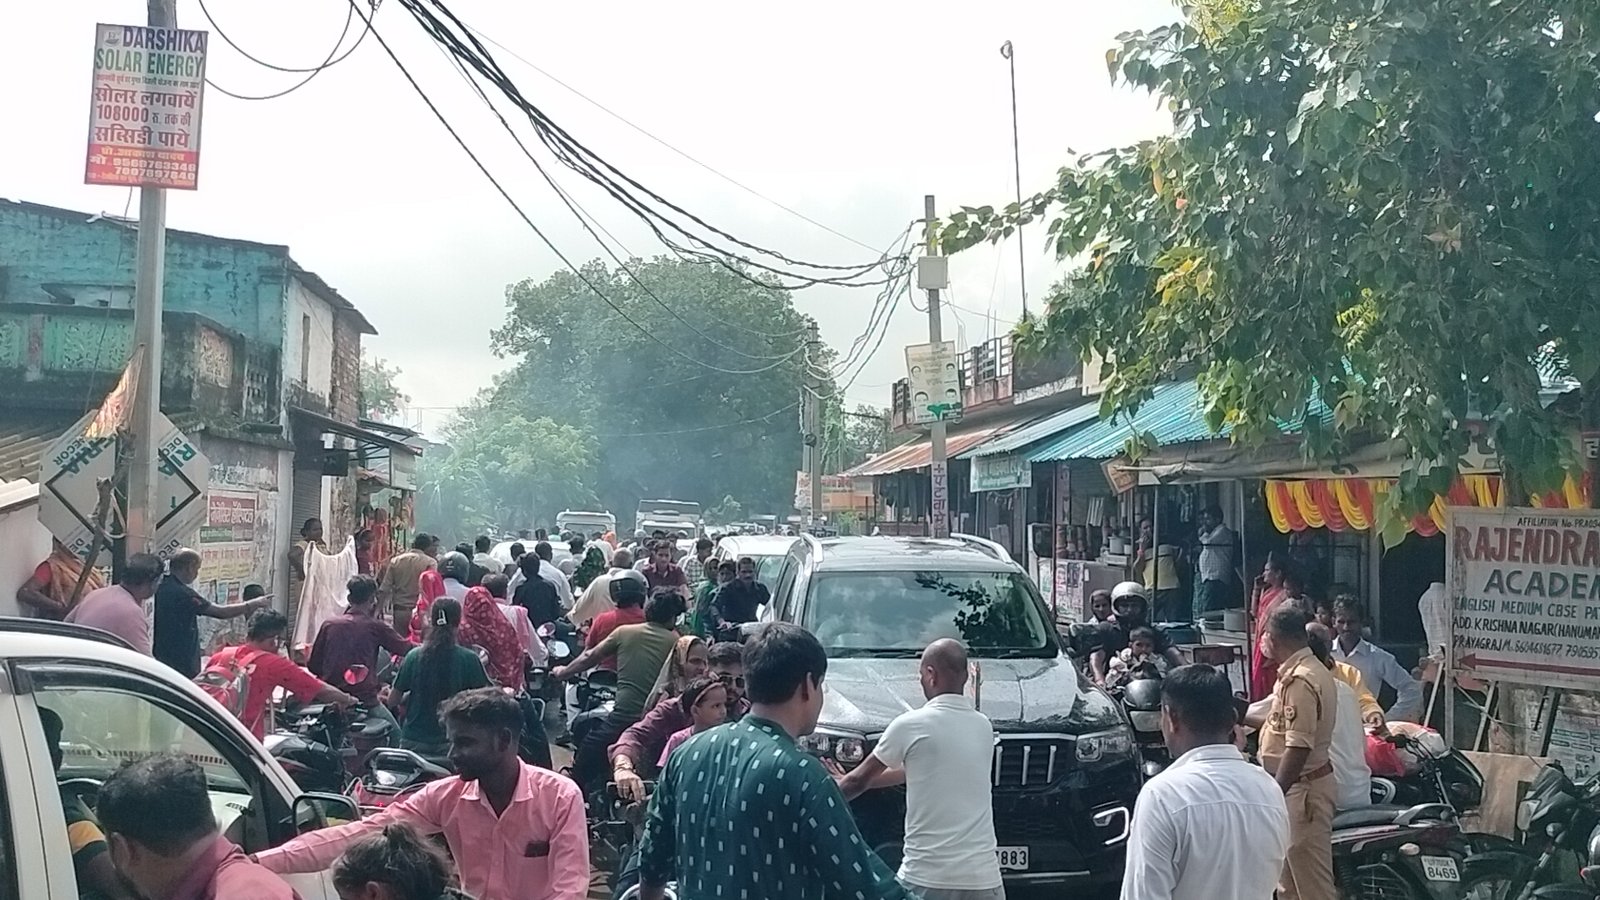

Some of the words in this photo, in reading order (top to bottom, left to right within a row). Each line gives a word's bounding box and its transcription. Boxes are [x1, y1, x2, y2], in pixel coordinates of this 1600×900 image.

[123, 26, 204, 53] DARSHIKA
[96, 48, 142, 73] SOLAR
[147, 52, 203, 78] ENERGY
[96, 84, 137, 104] सोलर
[97, 105, 149, 122] 108000
[180, 112, 191, 126] की
[1517, 517, 1558, 528] AFFILIATION
[1455, 526, 1600, 567] RAJENDRA
[1454, 596, 1495, 612] ENGLISH
[1501, 601, 1542, 617] MEDIUM
[1548, 603, 1577, 620] CBSE
[1427, 867, 1457, 879] 8469
